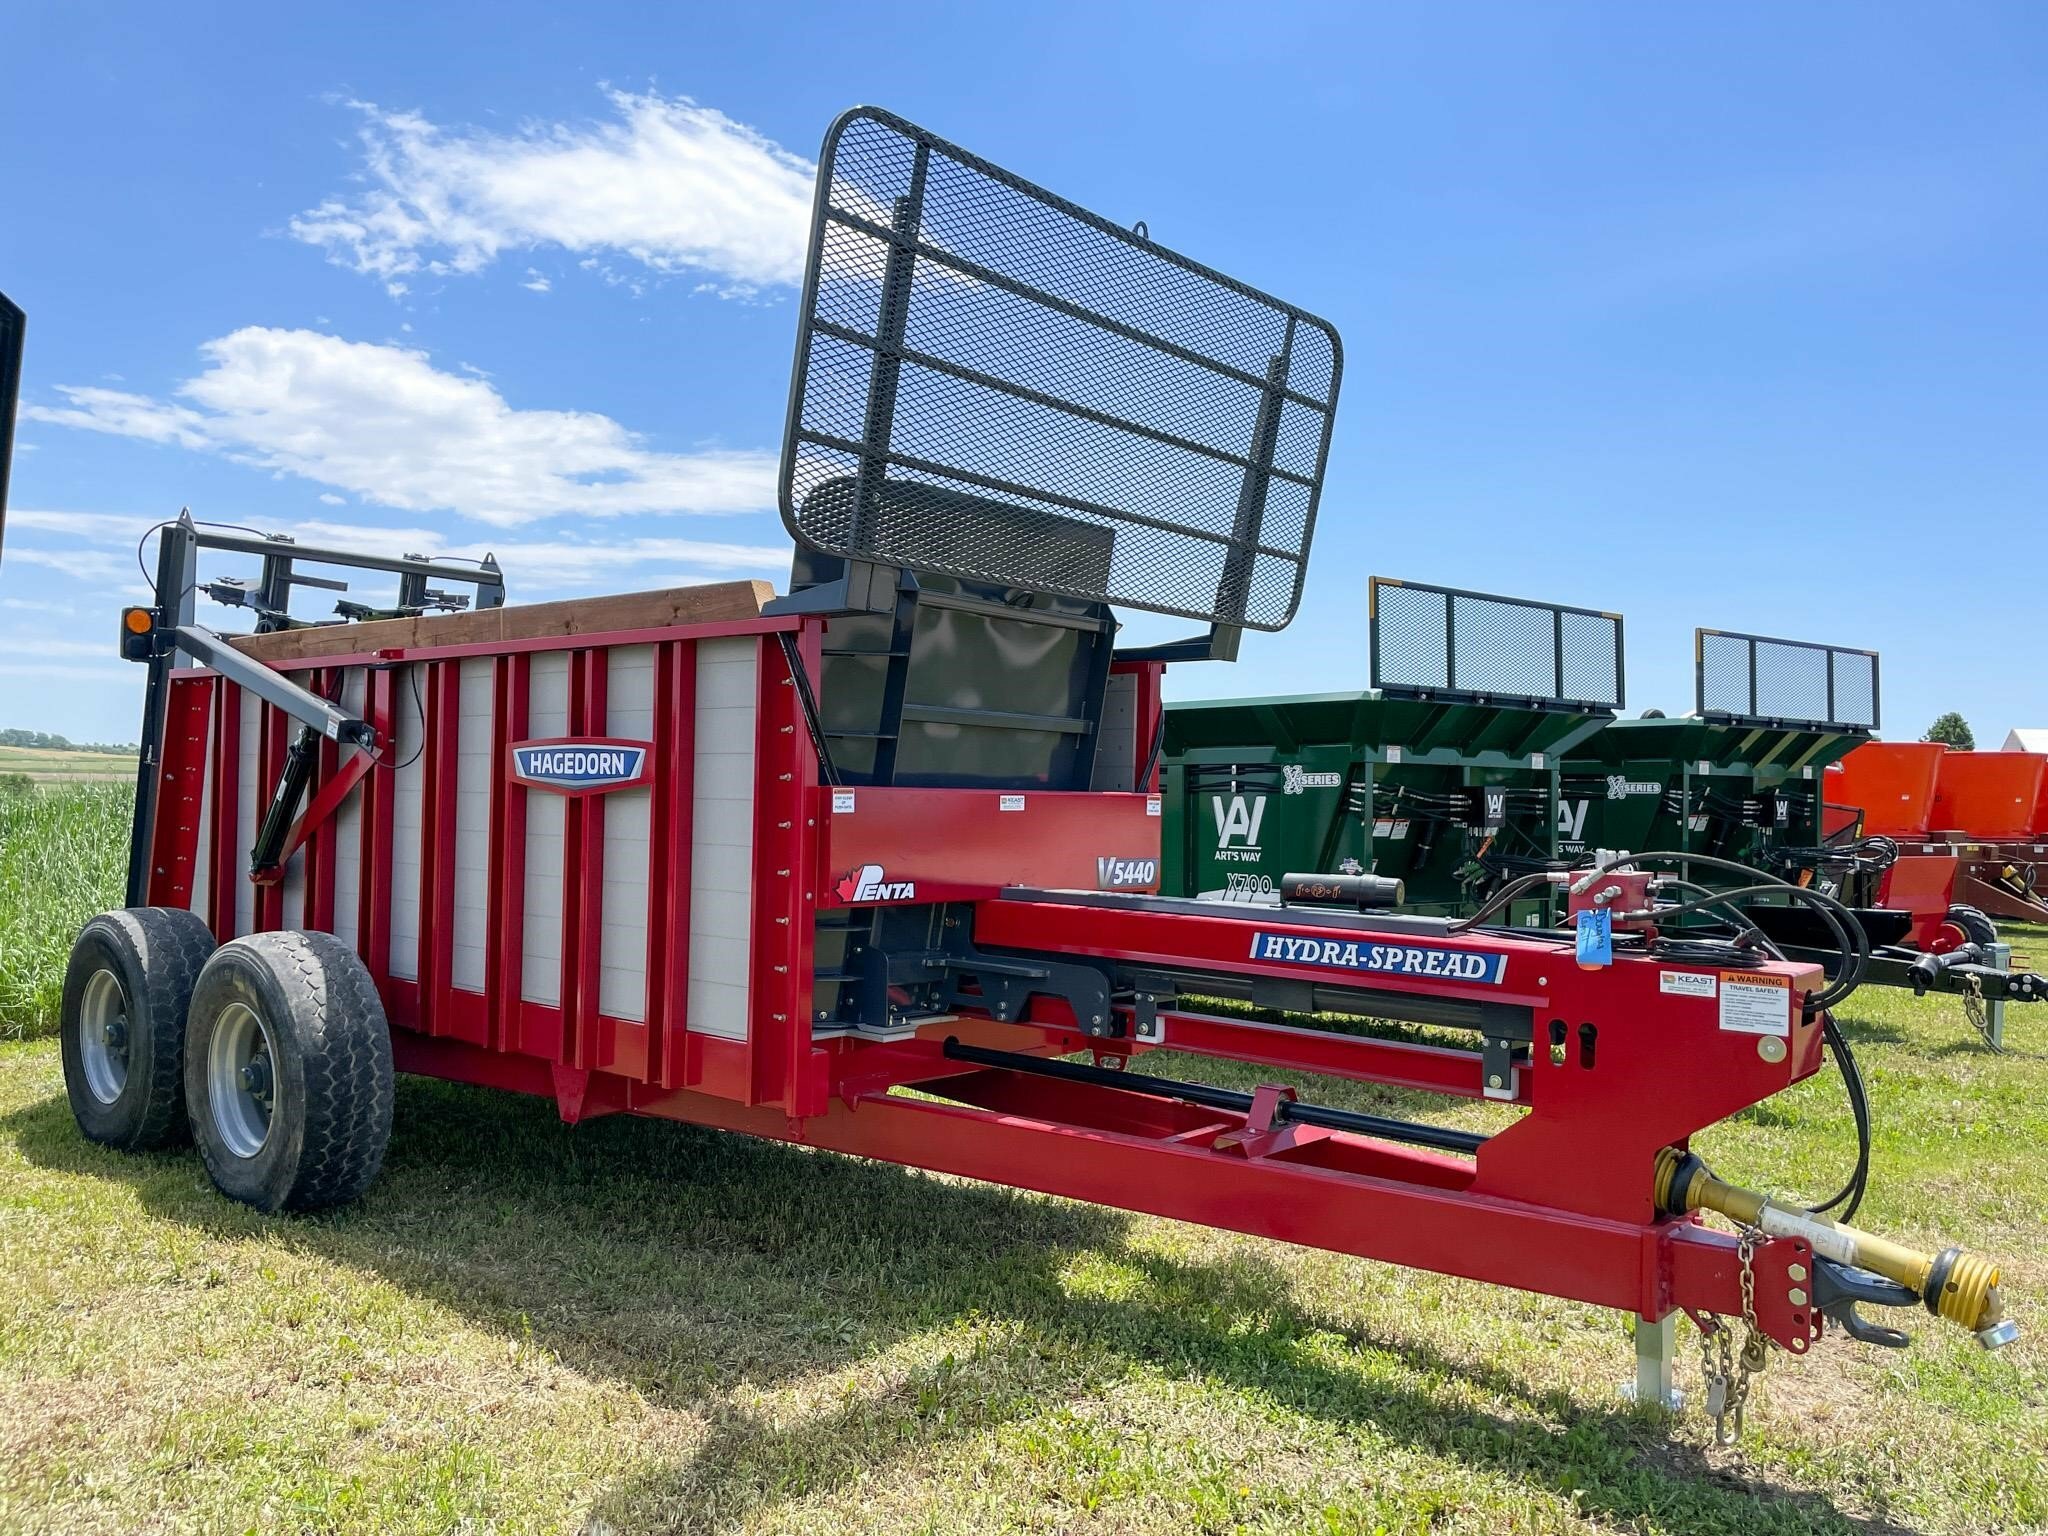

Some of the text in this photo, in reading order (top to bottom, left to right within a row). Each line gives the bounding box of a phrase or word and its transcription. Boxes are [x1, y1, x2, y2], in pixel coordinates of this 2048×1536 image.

[530, 753, 625, 775] HAGEDORN
[1301, 775, 1339, 785] SERIES
[1624, 784, 1659, 792] SERIES
[1214, 851, 1261, 862] ART'S WAY
[853, 865, 915, 901] PENTA
[1227, 873, 1272, 894] X700
[1263, 936, 1487, 979] HYDRA-SPREAD
[1677, 975, 1715, 985] KEAST
[1736, 975, 1783, 986] WARNING
[1730, 985, 1779, 995] TRAVEL SAFELY
